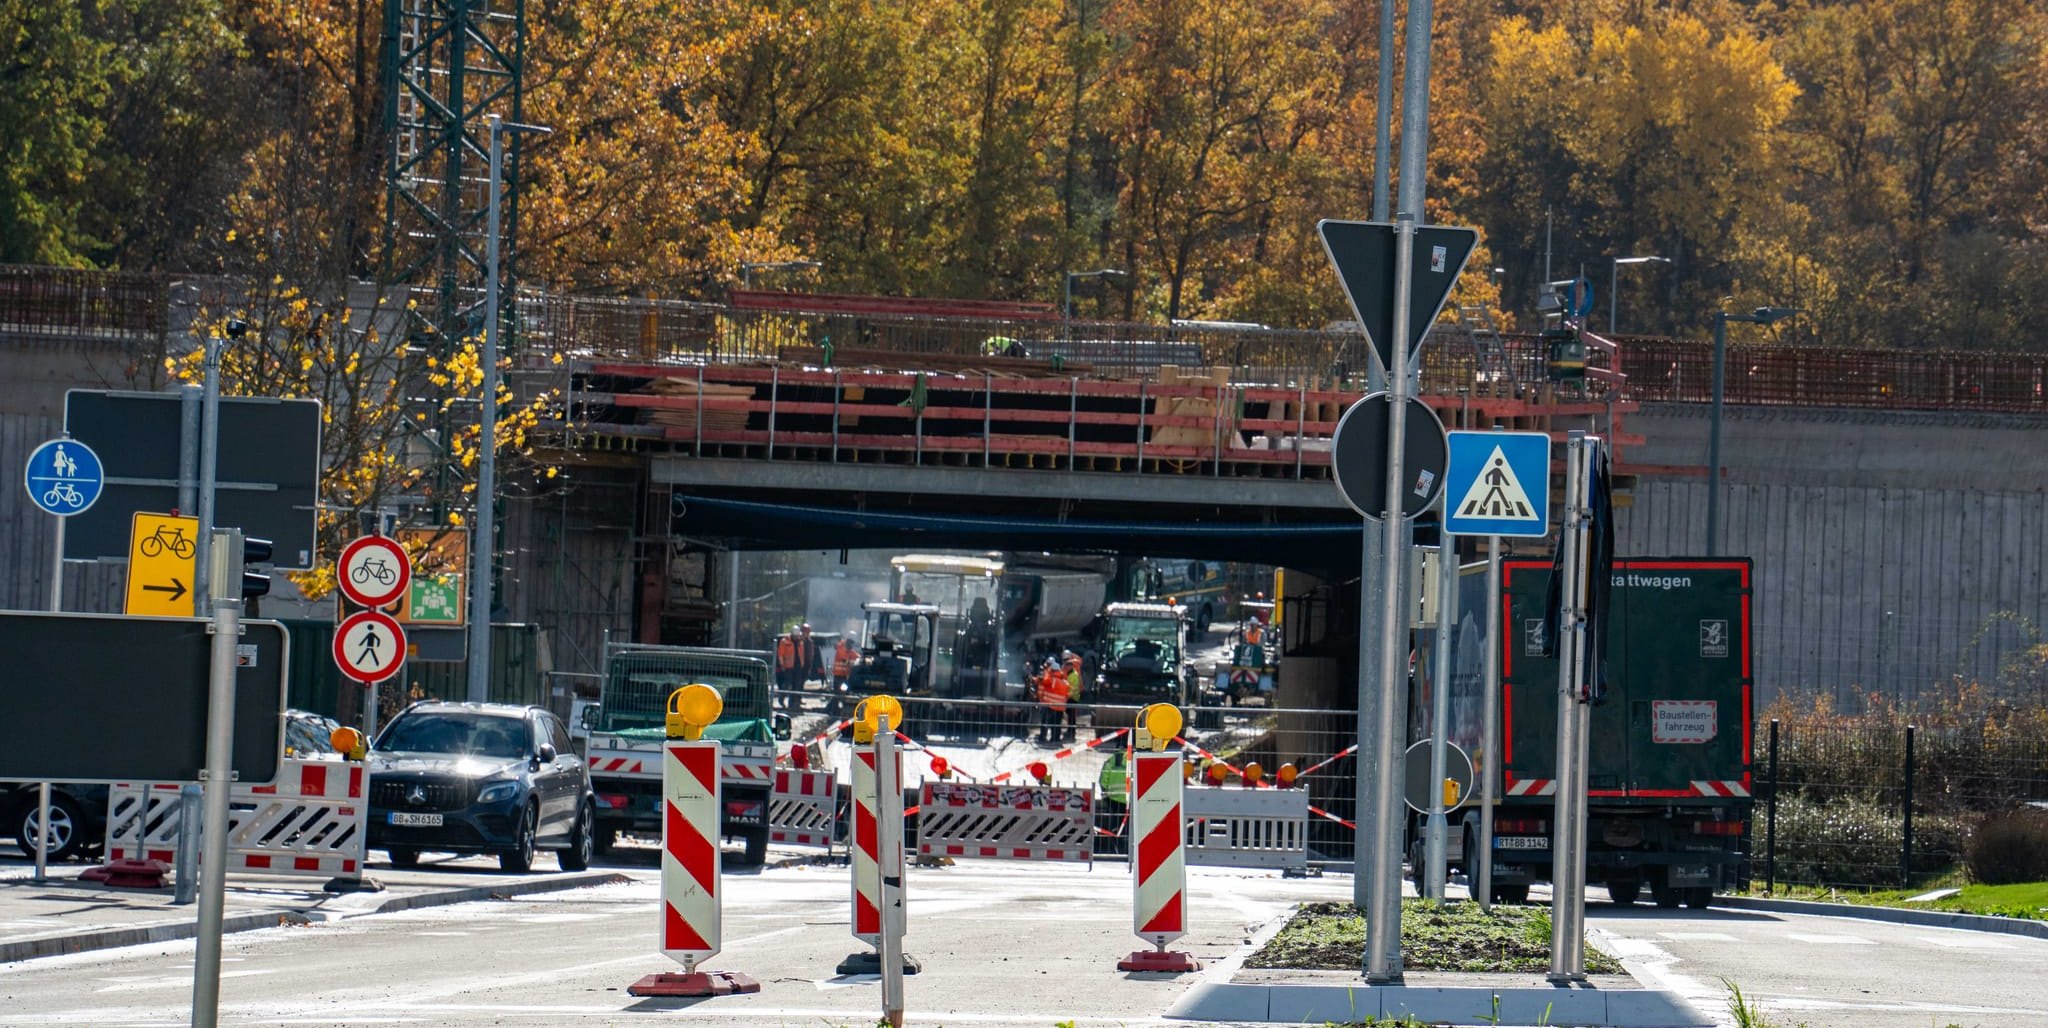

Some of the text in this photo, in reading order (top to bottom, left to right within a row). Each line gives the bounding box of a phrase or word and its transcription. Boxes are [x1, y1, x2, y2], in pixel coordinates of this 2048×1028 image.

[1659, 710, 1712, 720] Baustellen-
[1665, 722, 1705, 733] fahrzeug
[729, 815, 760, 824] MAN
